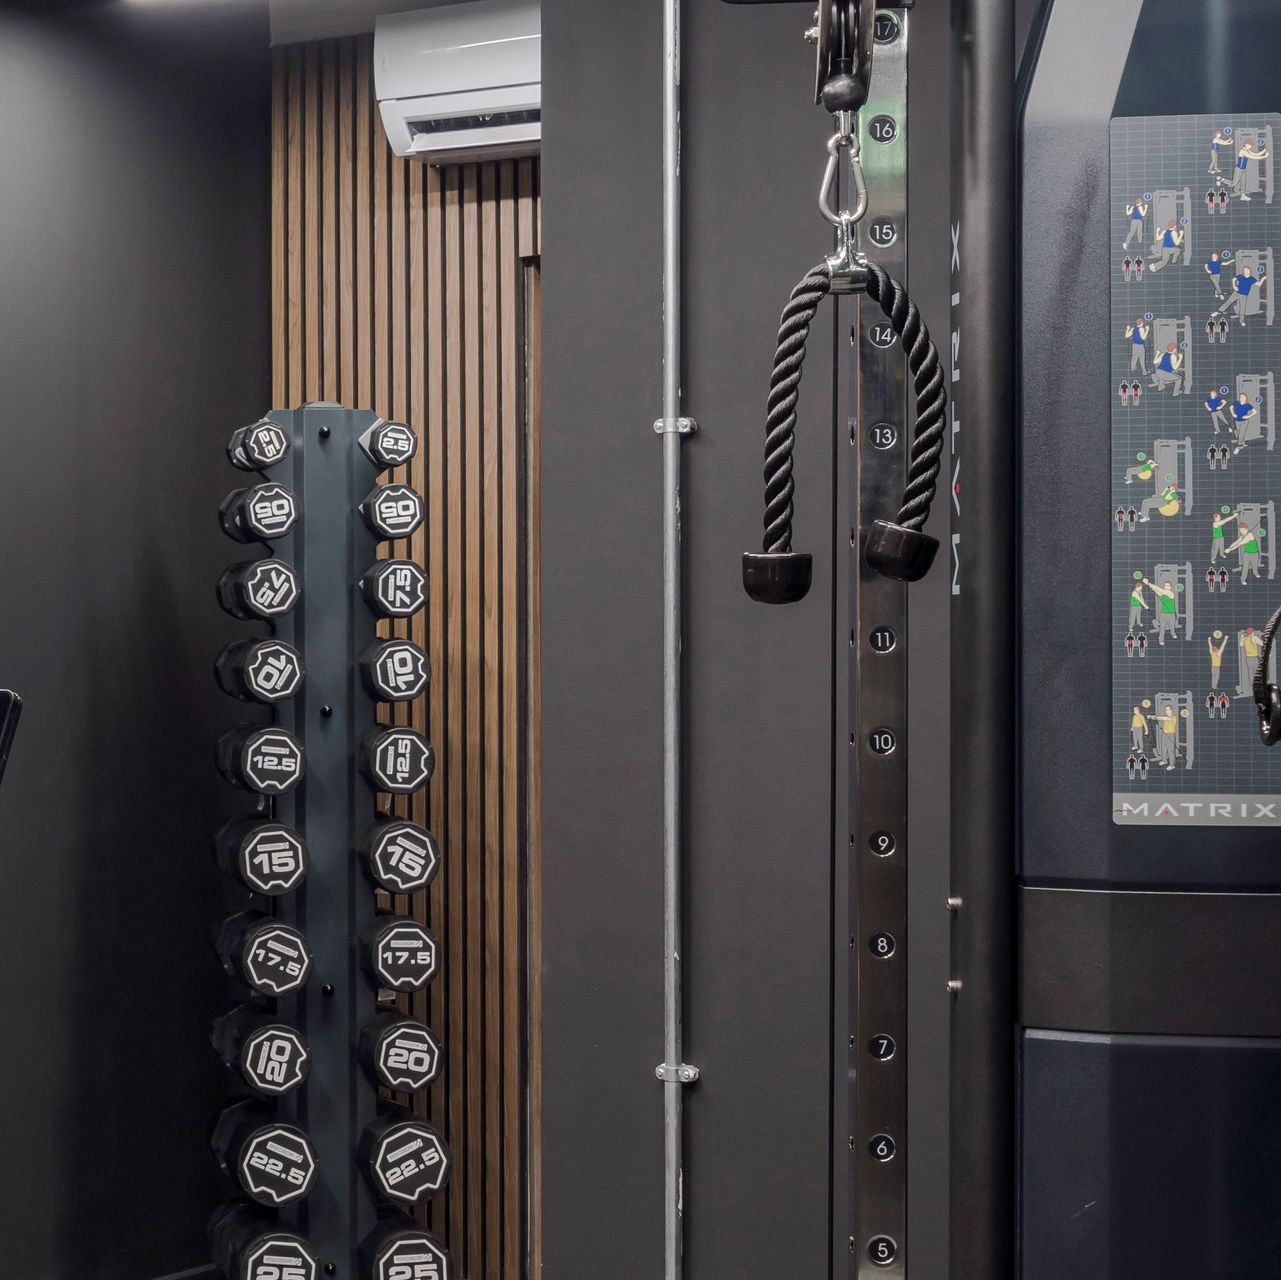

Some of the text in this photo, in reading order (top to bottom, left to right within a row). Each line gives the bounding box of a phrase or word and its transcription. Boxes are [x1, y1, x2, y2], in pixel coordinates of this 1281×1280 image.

[875, 21, 892, 37] 17
[874, 122, 893, 138] 16
[873, 224, 893, 240] 15
[874, 327, 892, 342] 14
[951, 220, 960, 595] MATRIX
[257, 430, 277, 458] 2.5
[382, 437, 410, 451] 2.5
[874, 428, 892, 444] 13
[255, 570, 287, 607] 7.5
[395, 569, 411, 607] 7.5
[875, 632, 890, 647] 11
[256, 654, 286, 690] 10
[393, 650, 415, 690] 10
[873, 734, 892, 750] 10
[252, 755, 296, 772] 12.5
[396, 739, 411, 783] 12.5
[1122, 802, 1277, 818] MATRIX
[878, 836, 889, 851] 9
[252, 850, 296, 874] 15
[386, 845, 426, 877] 15
[877, 937, 888, 953] 8
[255, 949, 302, 977] 17.5
[382, 951, 431, 965] 17.5
[878, 1039, 888, 1055] 7
[265, 1039, 291, 1083] 20
[387, 1047, 430, 1073] 20
[876, 1140, 888, 1156] 6
[249, 1151, 306, 1185] 22.5
[385, 1147, 440, 1186] 22.5
[877, 1243, 888, 1258] 5
